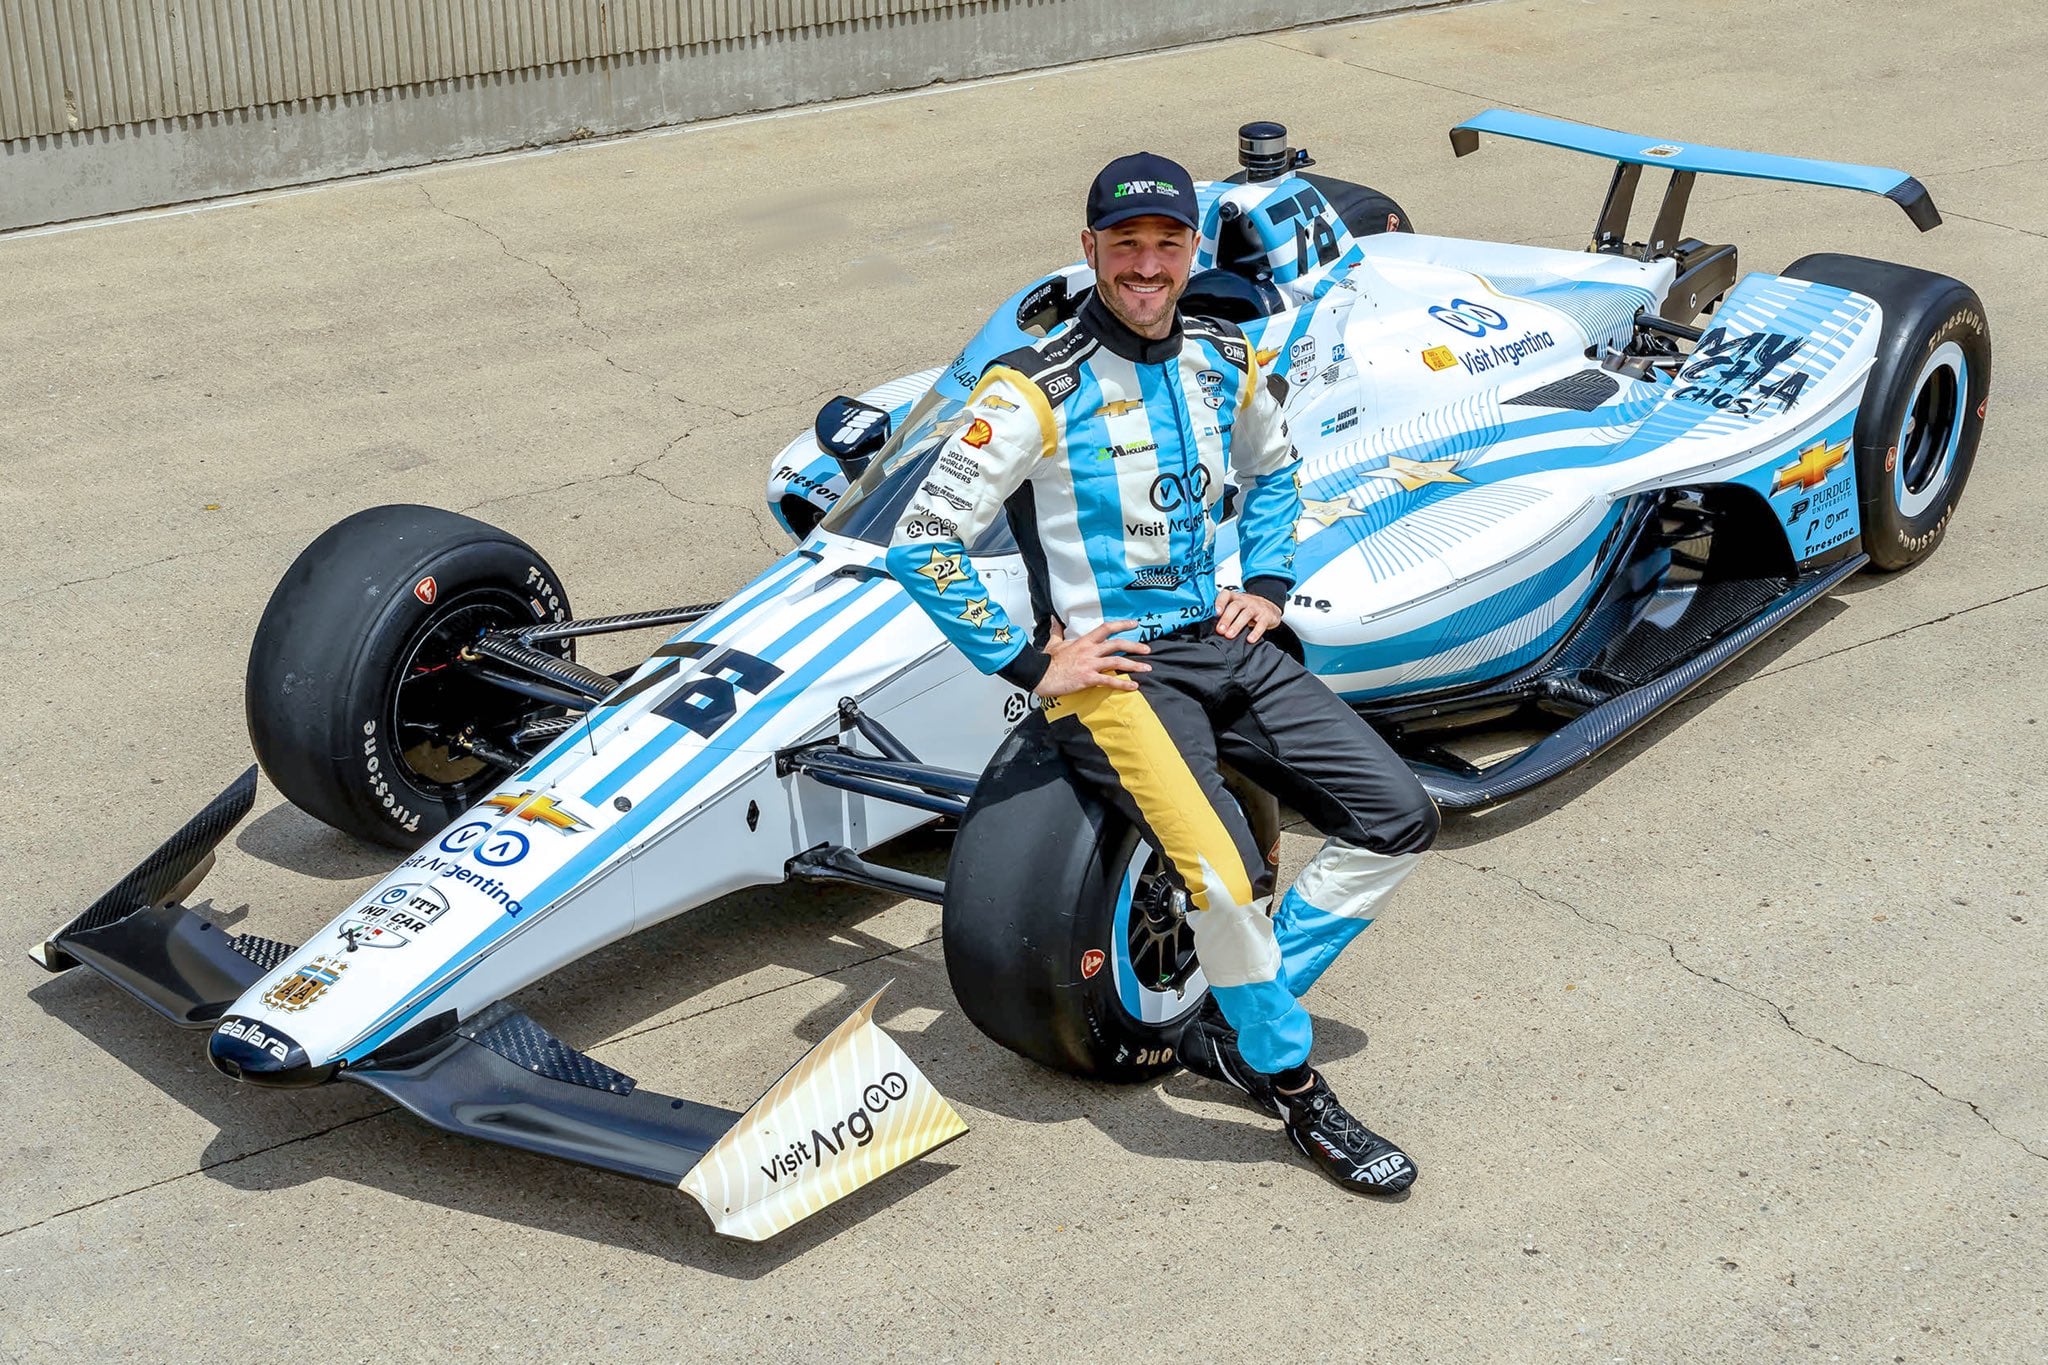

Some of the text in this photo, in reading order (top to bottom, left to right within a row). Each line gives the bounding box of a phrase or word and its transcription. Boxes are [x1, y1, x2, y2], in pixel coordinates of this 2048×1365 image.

[1265, 186, 1340, 278] 78
[1928, 307, 1983, 352] Firestone
[1224, 345, 1246, 361] OMP
[1301, 341, 1313, 353] NTT
[1458, 349, 1494, 376] Visit
[1490, 331, 1555, 366] Argentina
[1290, 353, 1316, 369] INDYCAR
[1048, 376, 1073, 394] OMP
[1335, 417, 1359, 433] CANAPINO
[1126, 442, 1159, 455] HOLLINGER
[939, 463, 972, 484] WINNERS
[940, 456, 980, 478] WORLD CUP
[963, 457, 980, 470] FIFA
[772, 466, 842, 501] Fireston
[1812, 477, 1851, 506] PURDUE
[1835, 508, 1849, 522] NTT
[1126, 522, 1165, 537] Visit
[1804, 526, 1855, 558] Firestone
[933, 560, 957, 580] 22
[1135, 564, 1180, 580] TERMAS
[600, 641, 785, 740] 78
[363, 719, 421, 833] Firestone
[420, 857, 524, 918] Argentina
[218, 1019, 289, 1062] dallara
[760, 1107, 874, 1183] Visit Arg
[1310, 1131, 1347, 1160] one
